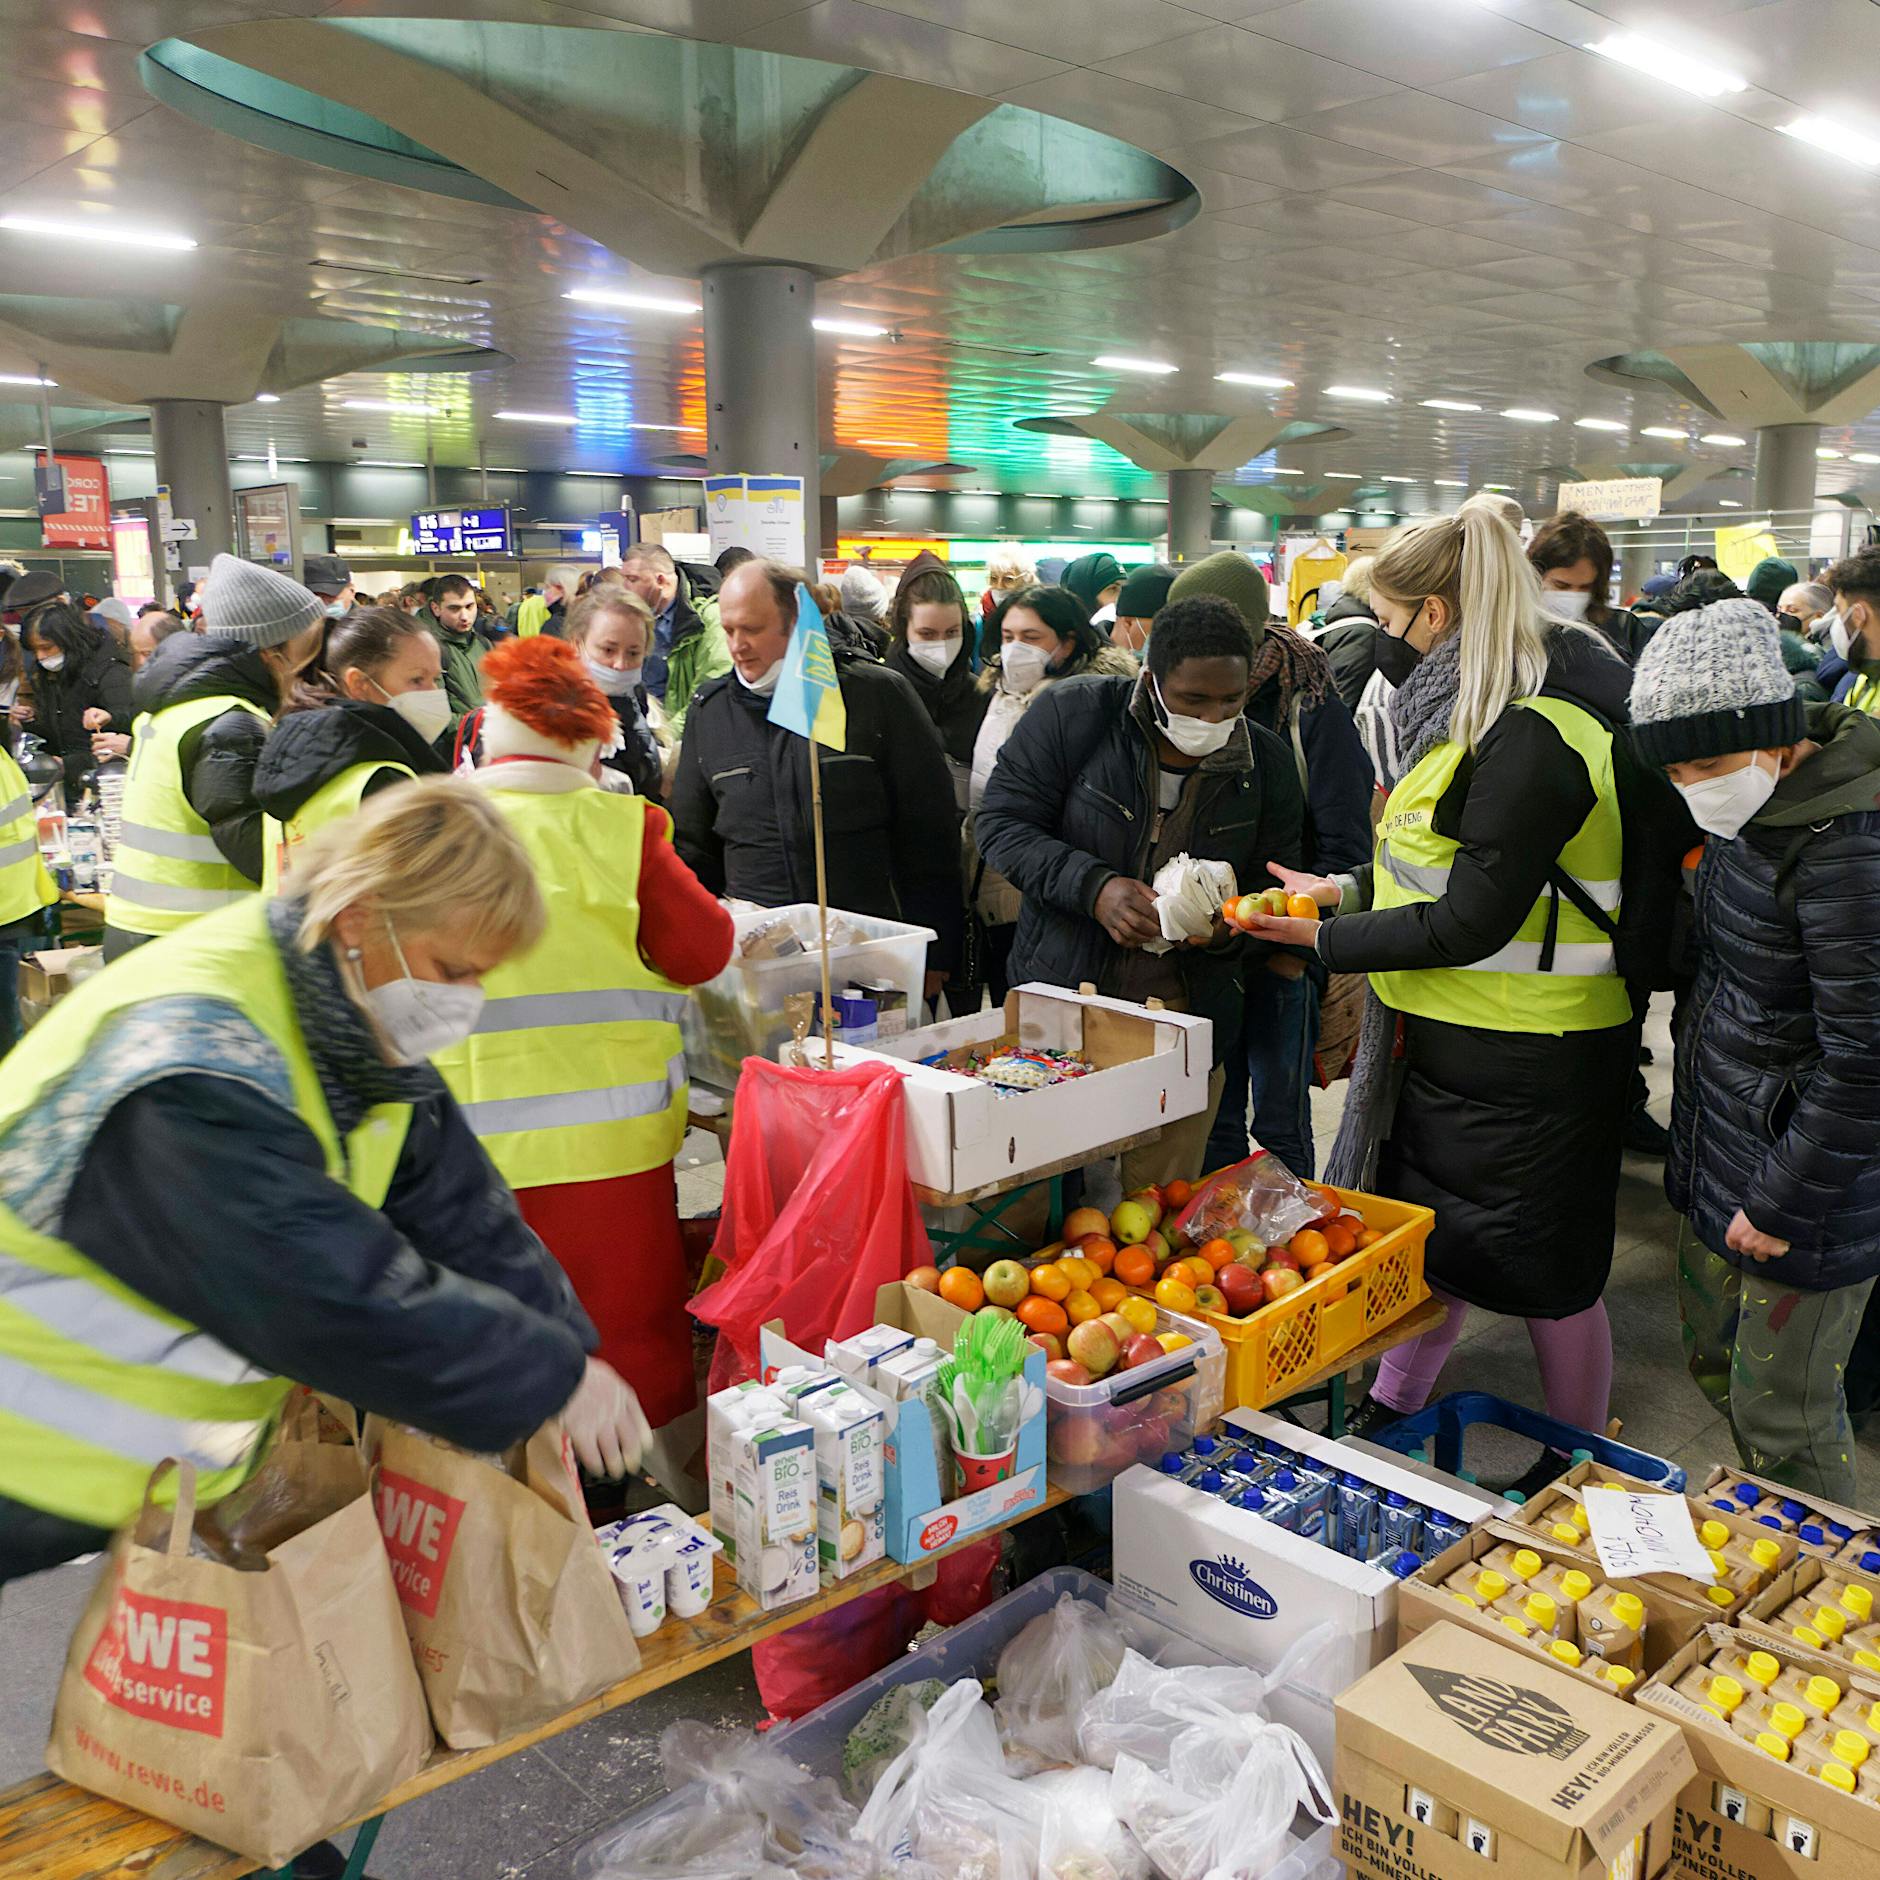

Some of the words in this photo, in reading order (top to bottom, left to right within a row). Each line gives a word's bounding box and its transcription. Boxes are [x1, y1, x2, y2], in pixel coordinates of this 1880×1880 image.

[1575, 484, 1604, 498] MEN
[778, 1488, 798, 1500] Reis
[1196, 1563, 1272, 1614] Christinen
[1551, 1772, 1600, 1811] HEY!
[1342, 1792, 1415, 1857] HEY!
[1342, 1823, 1364, 1845] ICH
[1367, 1837, 1390, 1860] BIN
